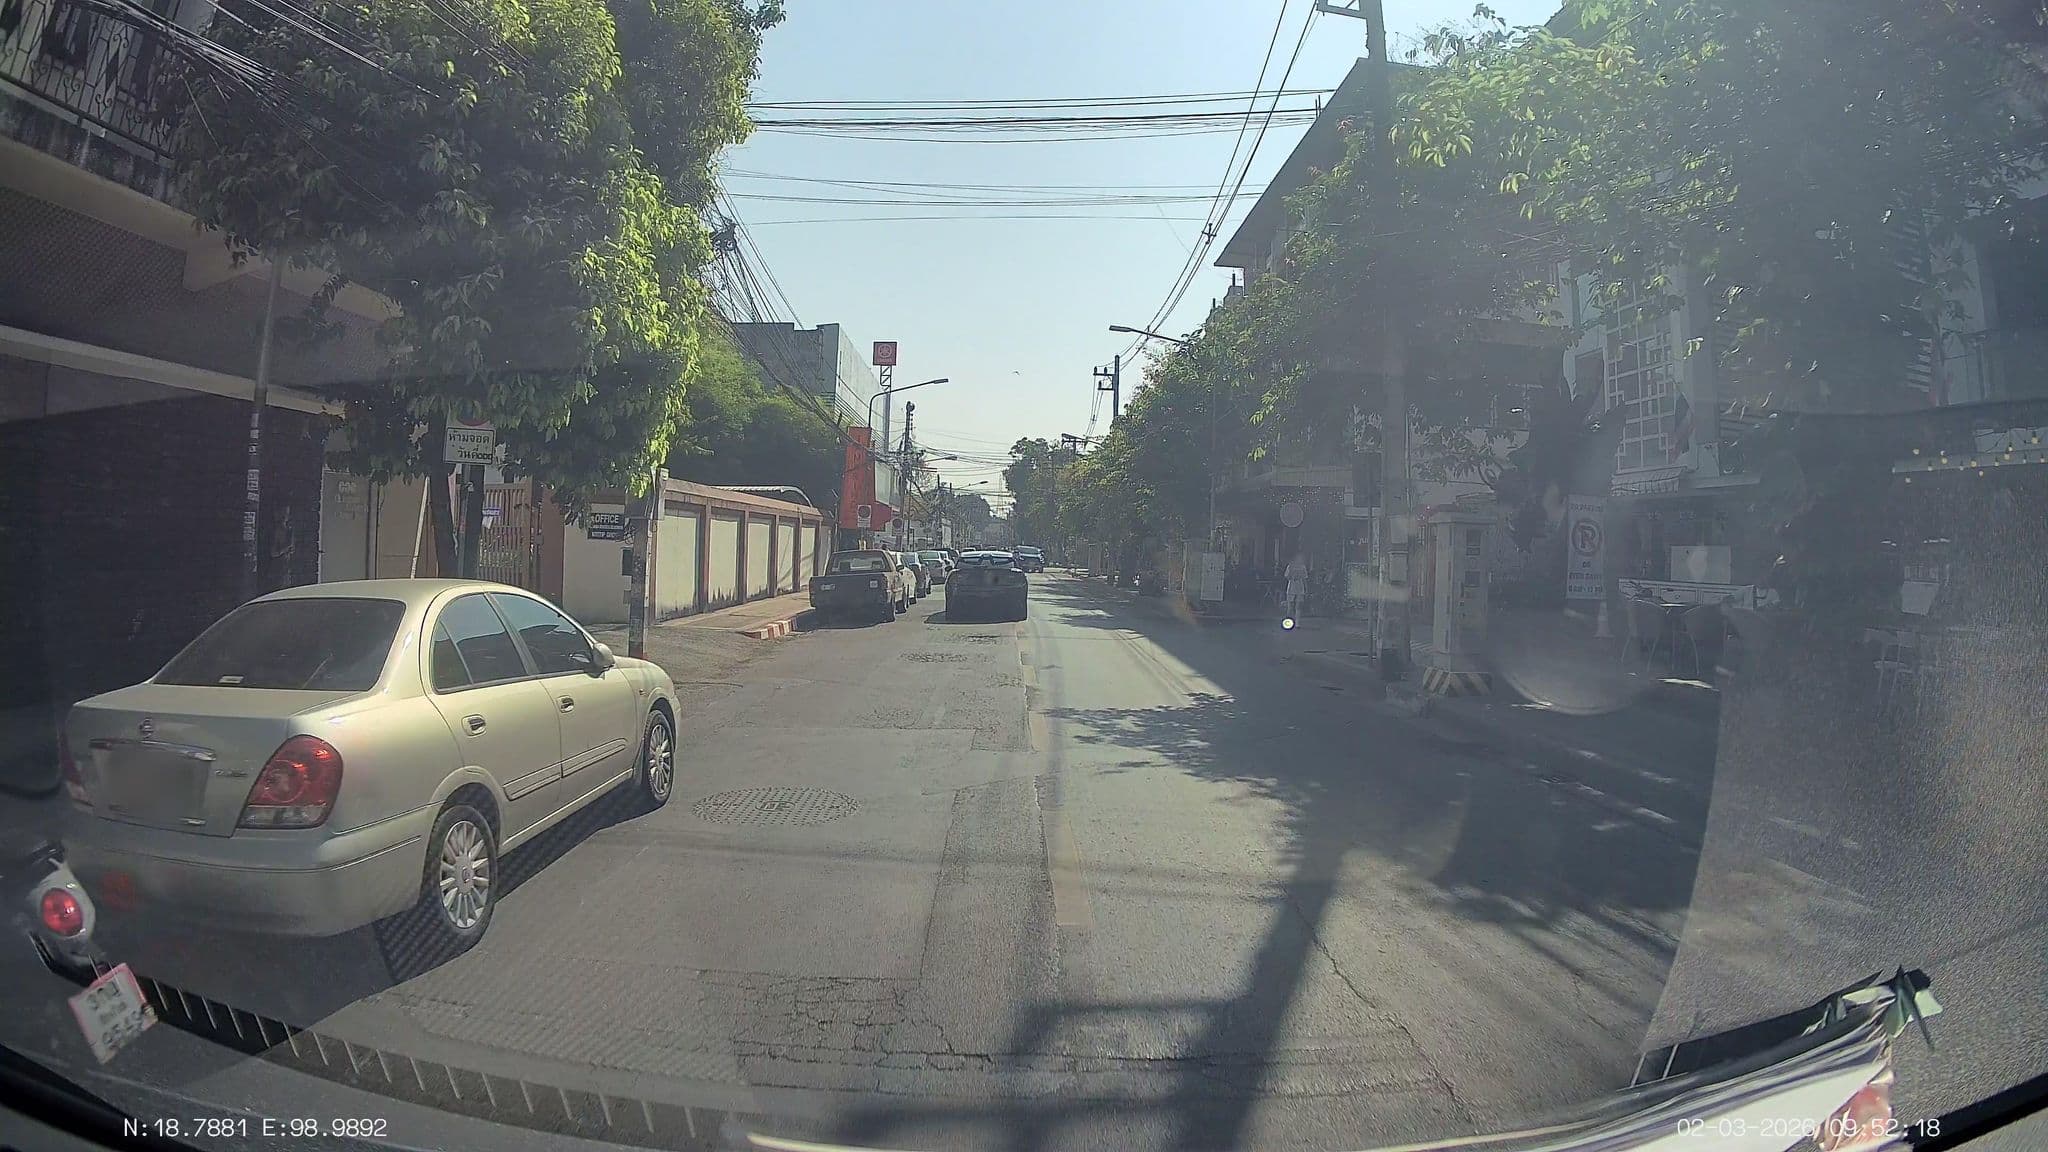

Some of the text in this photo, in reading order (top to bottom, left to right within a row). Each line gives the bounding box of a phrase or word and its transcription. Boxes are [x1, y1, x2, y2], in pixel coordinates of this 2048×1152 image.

[449, 430, 490, 444] ห้ามจอด
[595, 514, 620, 524] OFFICE
